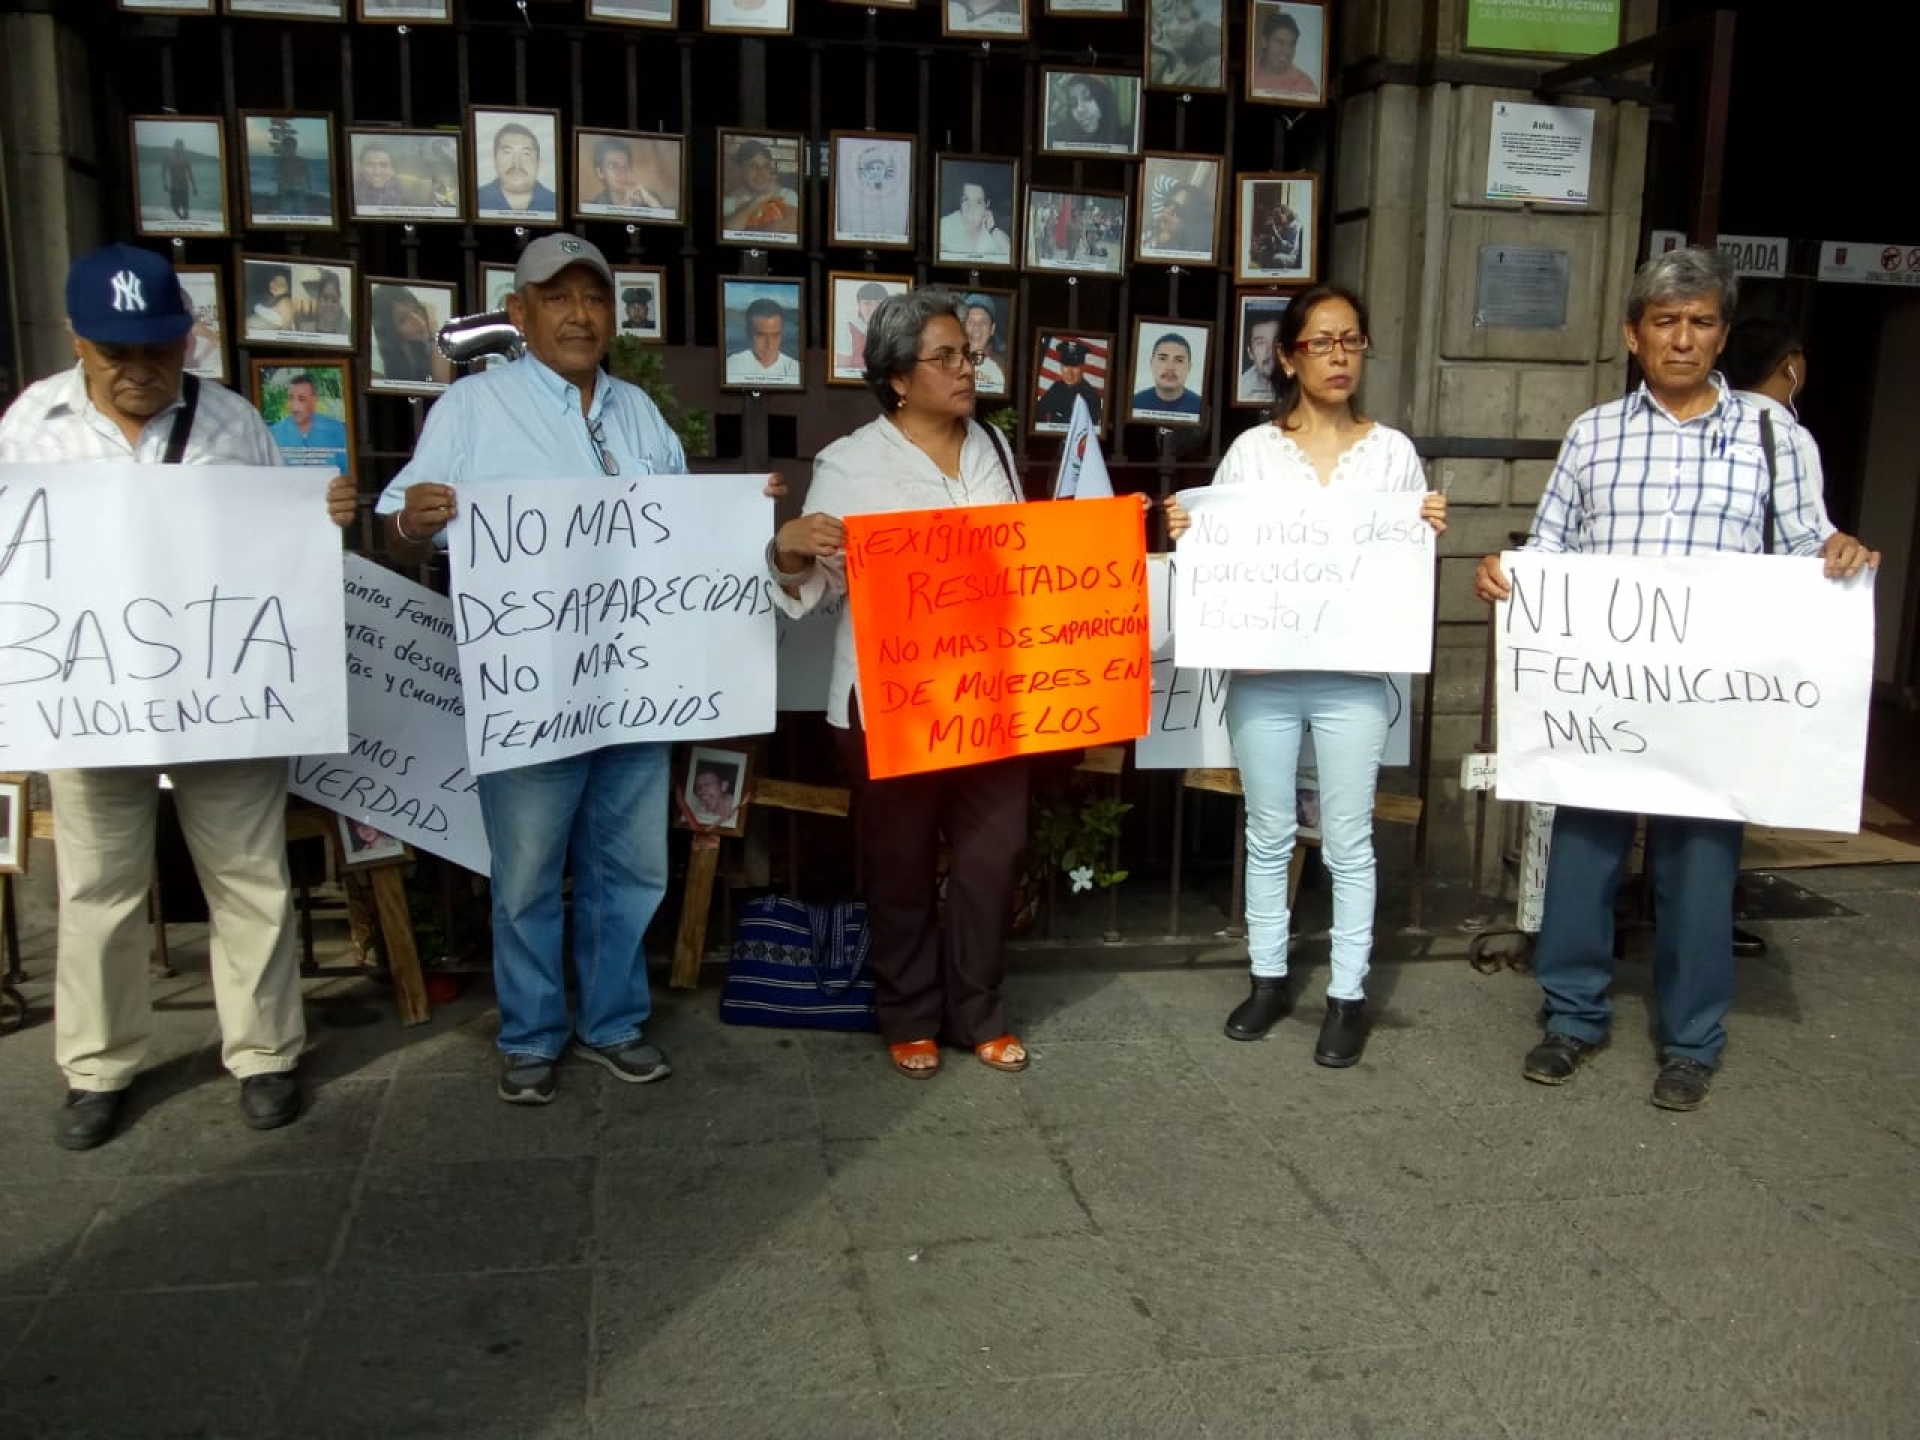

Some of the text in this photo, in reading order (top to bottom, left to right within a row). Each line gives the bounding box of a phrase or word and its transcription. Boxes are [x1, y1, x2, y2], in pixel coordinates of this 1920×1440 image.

[0, 484, 54, 580] A
[471, 482, 671, 568] NO MÁS
[1194, 512, 1230, 547] No
[1256, 507, 1329, 546] más
[0, 585, 297, 686] BASTA
[456, 567, 773, 646] DESAPARECIDAS
[878, 603, 1148, 665] NO MAS DESAPARICIÓN
[1506, 567, 1692, 643] NI UN
[480, 632, 650, 701] NO MÁS
[880, 656, 1142, 715] DE MUJERES EN
[1506, 645, 1821, 709] FEMINICIDIO
[37, 686, 294, 739] VIOLENCIA
[480, 684, 723, 757] FEMINICIDIOS
[928, 705, 1102, 754] MORELOS
[1543, 705, 1648, 755] MÁS
[293, 755, 449, 841] VERDAD.
